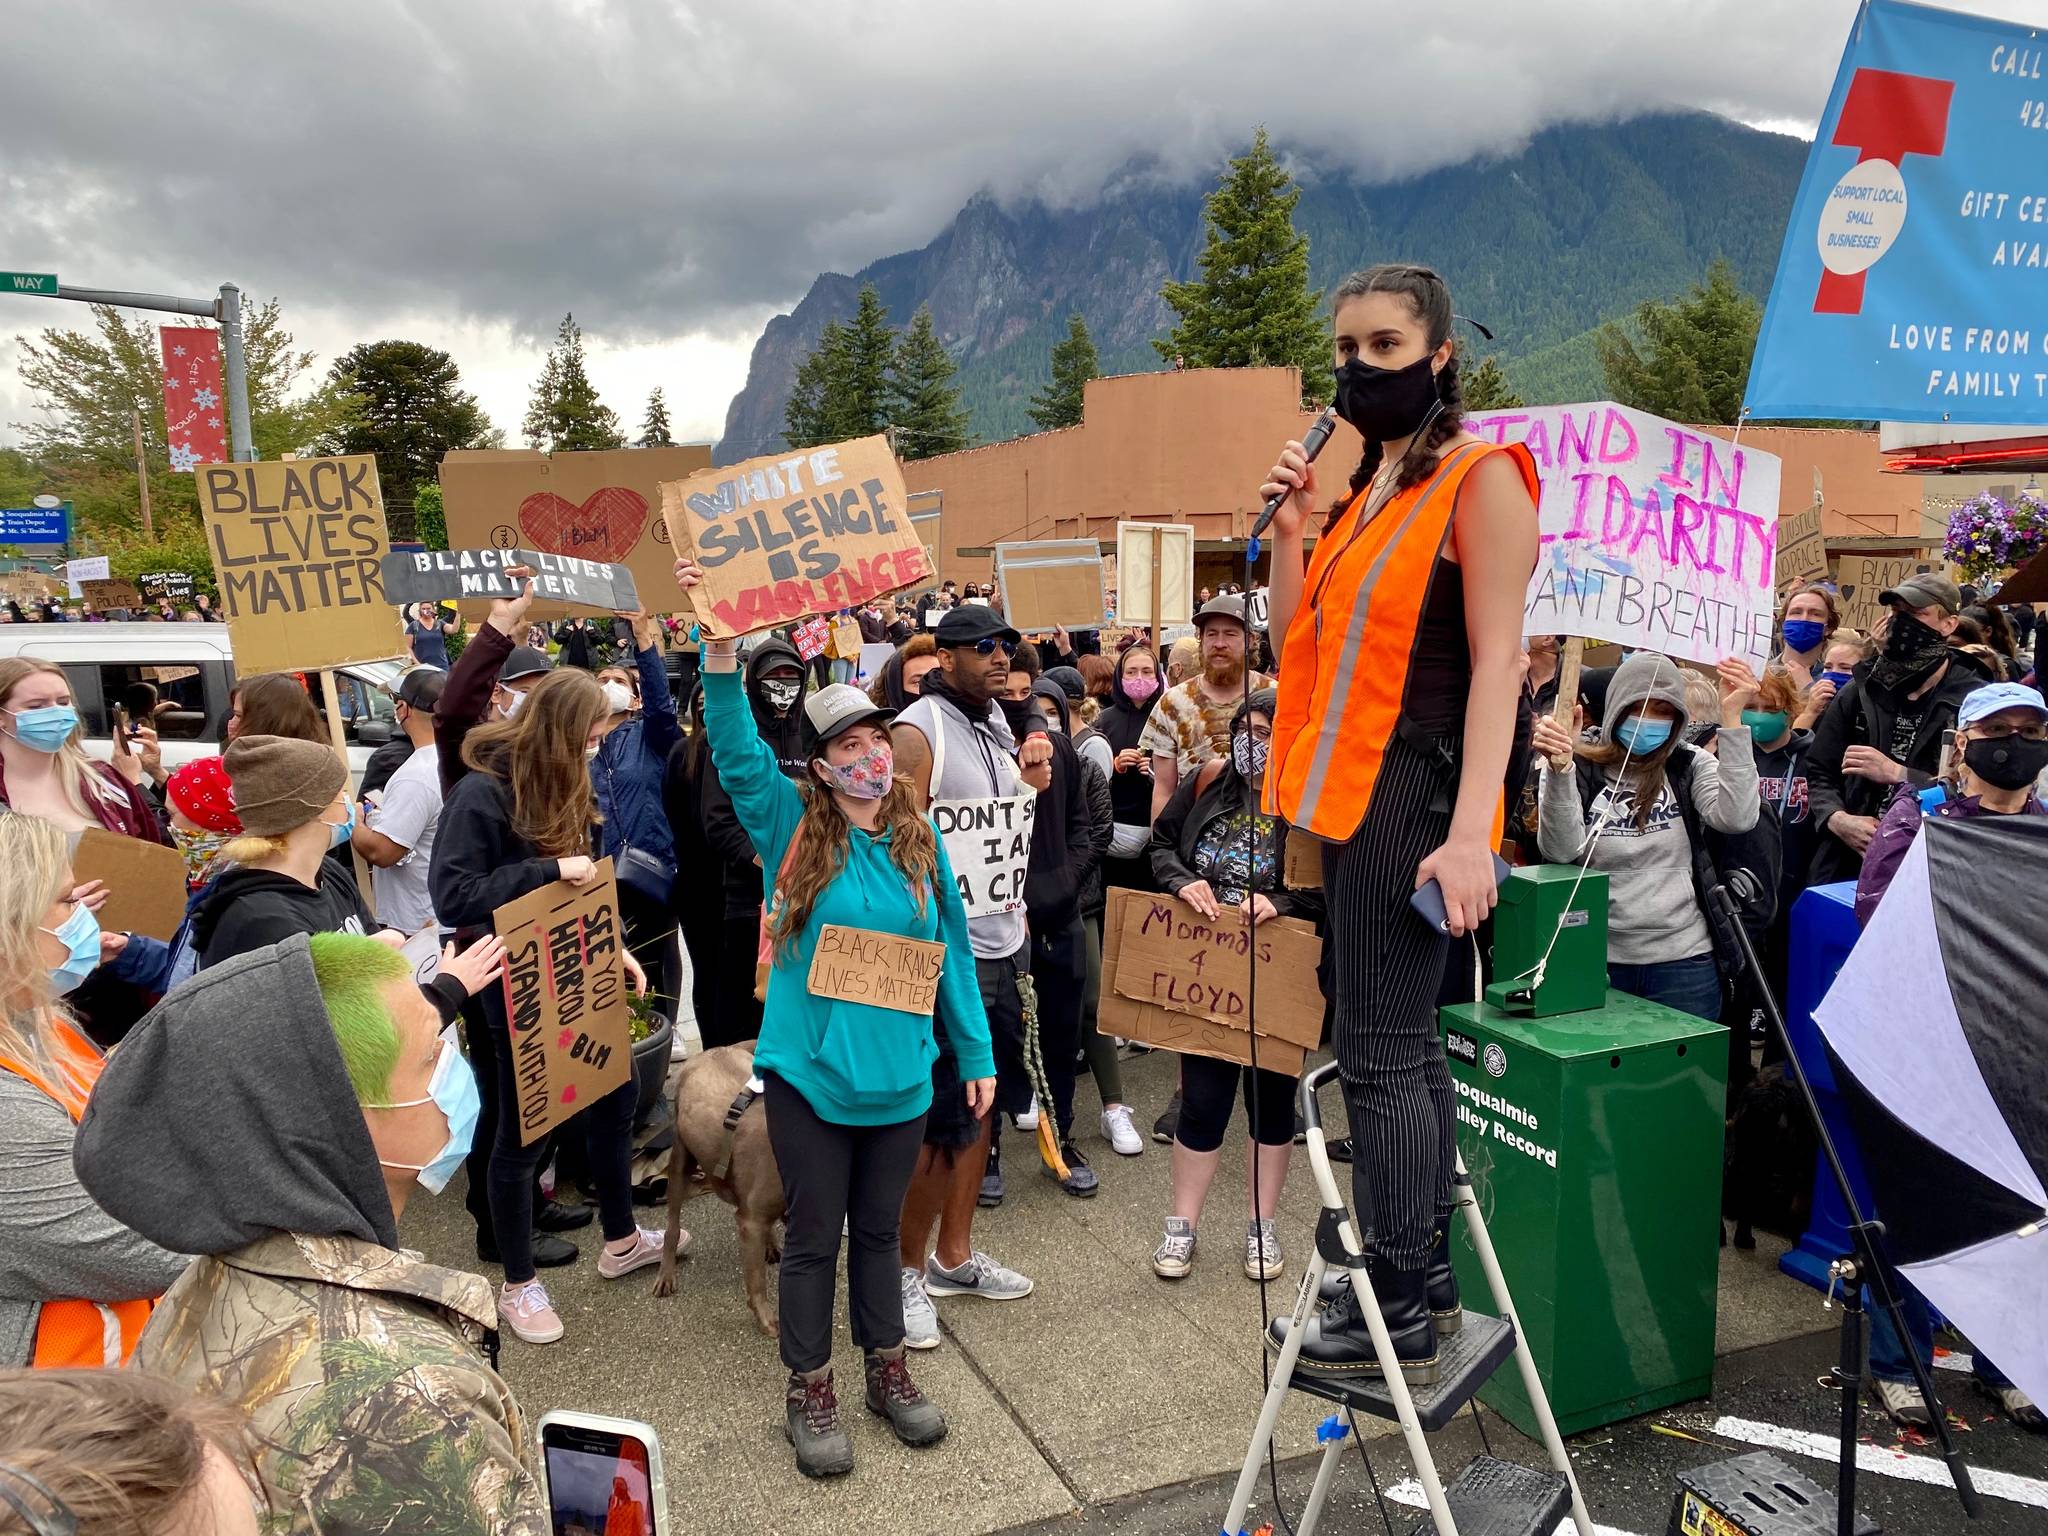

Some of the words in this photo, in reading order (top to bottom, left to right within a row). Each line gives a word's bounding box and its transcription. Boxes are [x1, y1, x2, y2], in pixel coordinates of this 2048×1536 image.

[1990, 45, 2041, 79] CALL
[2020, 99, 2048, 130] 42
[1834, 185, 1873, 202] SUPPORT
[1873, 188, 1904, 204] LOCAL
[1961, 190, 2009, 219] GIFT
[2019, 195, 2048, 223] CE
[1846, 210, 1874, 225] SMALL
[1827, 232, 1881, 249] BUSINESSES!
[13, 277, 43, 289] WAY
[1890, 323, 1952, 351] LOVE
[1966, 329, 2029, 355] FROM
[190, 356, 204, 375] Let
[1927, 370, 2021, 396] FAMILY
[167, 409, 197, 433] Snow
[687, 447, 843, 520] WHITE
[1665, 427, 1744, 508] IN
[205, 460, 374, 515] BLACK
[214, 513, 379, 567] LIVES
[696, 478, 897, 568] SILENCE
[1785, 509, 1820, 545] JUSTICE
[414, 550, 518, 572] BLACK
[538, 554, 615, 582] LIVES
[767, 539, 842, 582] IS
[1790, 540, 1820, 571] PEACE
[144, 583, 169, 596] Black
[166, 587, 189, 597] Lives
[222, 558, 386, 618] MATTER
[461, 574, 579, 597] MATTER
[710, 545, 930, 634] VIOLENCE
[1861, 560, 1912, 588] BLACK
[96, 596, 133, 608] POLICE
[1524, 568, 1616, 620] ANT
[1616, 574, 1774, 657] BREATHE
[1860, 586, 1881, 606] LI
[933, 800, 1015, 834] DON'T
[983, 838, 1003, 864] I
[957, 874, 975, 905] A
[582, 904, 616, 965] SEE
[548, 917, 584, 994] HEAR
[821, 928, 890, 969] BLACK
[895, 942, 940, 980] TRANS
[1189, 949, 1207, 976] 4
[506, 940, 541, 1032] STAND
[591, 957, 618, 1012] YOU
[812, 960, 869, 995] LIVES
[874, 975, 934, 1011] MATTER
[1152, 971, 1244, 1014] FLOYD
[556, 984, 585, 1025] YOU
[518, 1026, 549, 1095] WITH
[569, 1032, 611, 1070] BLM
[522, 1079, 549, 1130] YOU
[1456, 1104, 1489, 1136] lley
[1493, 1120, 1557, 1168] Record
